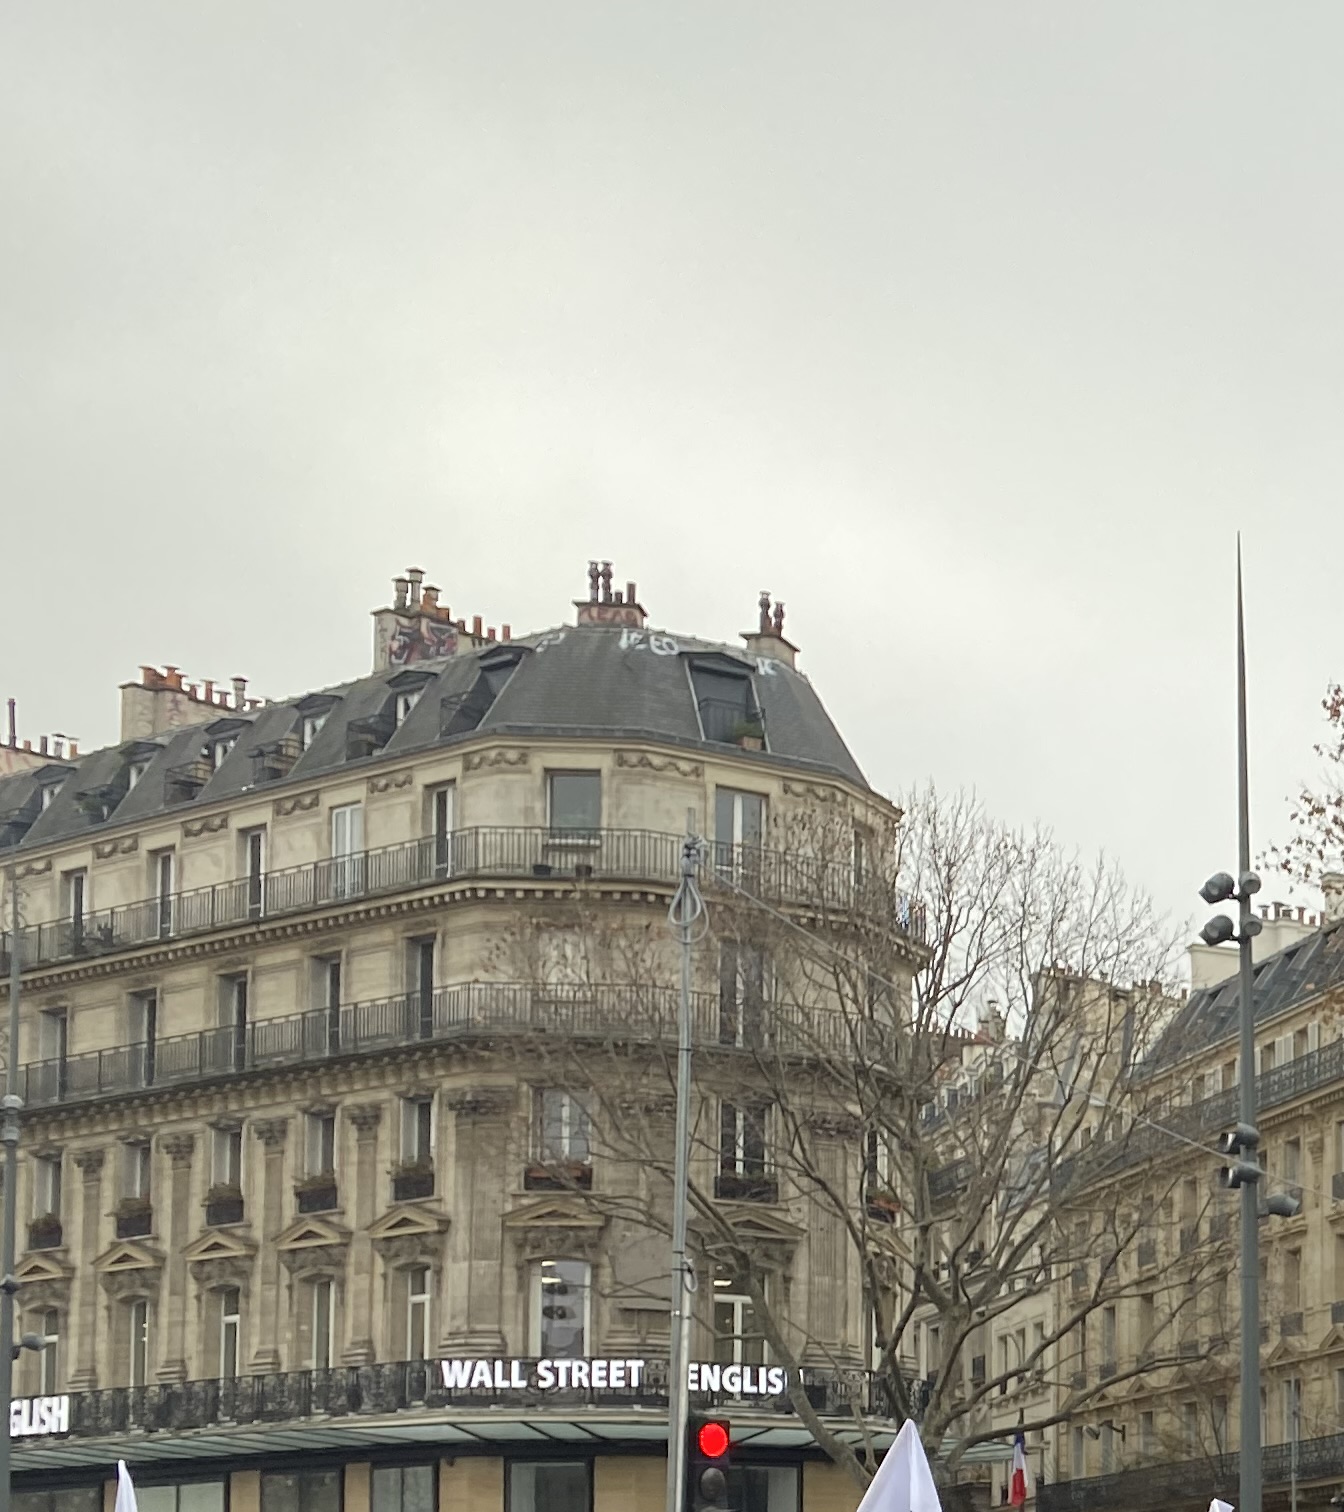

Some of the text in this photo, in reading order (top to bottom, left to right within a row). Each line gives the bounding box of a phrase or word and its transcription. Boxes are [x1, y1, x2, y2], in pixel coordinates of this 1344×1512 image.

[442, 1359, 803, 1395] WALL STREET ENGLIS
[10, 1396, 69, 1437] GLISH
